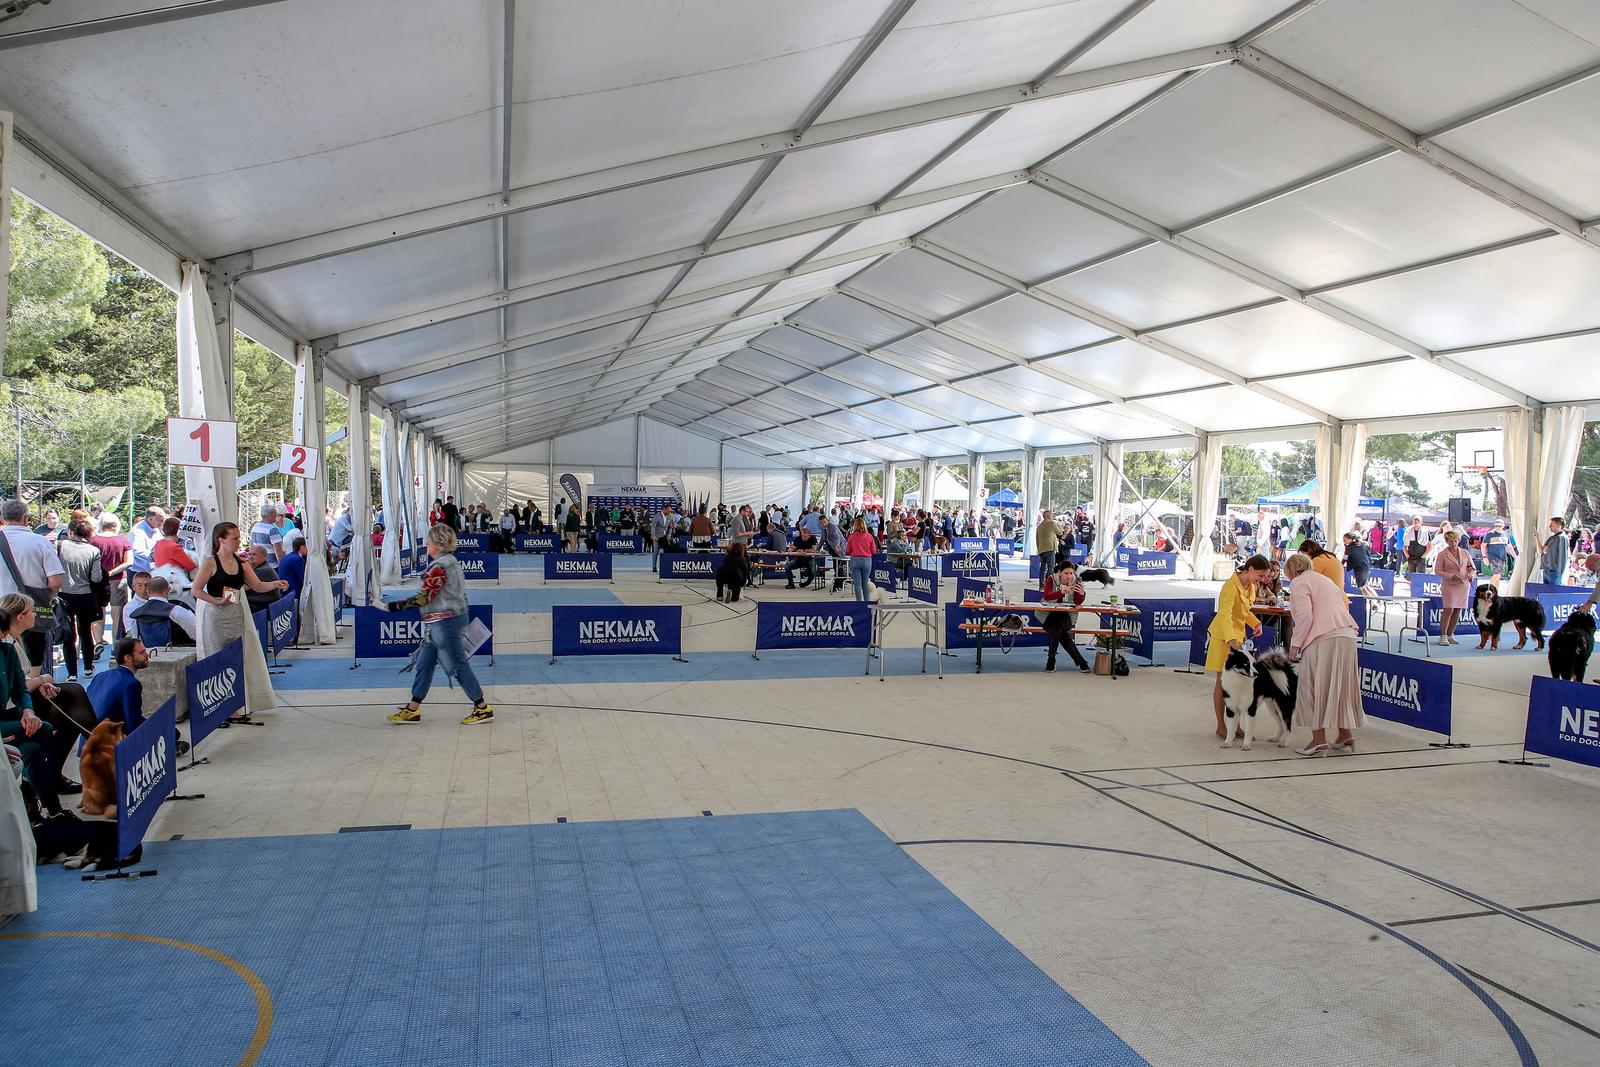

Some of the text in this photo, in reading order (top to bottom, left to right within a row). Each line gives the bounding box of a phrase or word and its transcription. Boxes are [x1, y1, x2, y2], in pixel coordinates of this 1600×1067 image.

[190, 422, 210, 462] 1
[290, 447, 307, 475] 2
[415, 476, 420, 487] 4
[980, 489, 986, 497] 3
[523, 539, 554, 547] NEKMAR
[606, 540, 635, 549] NEKMAR
[960, 542, 984, 550] NEKMAR
[556, 561, 599, 573] NEKMAR
[672, 561, 713, 573] NEKMAR
[952, 560, 989, 571] NEKMAR
[1136, 560, 1167, 570] NEKMAR
[1423, 582, 1443, 595] NEK
[1153, 611, 1196, 626] EKMAR
[579, 619, 660, 642] NEKMAR
[781, 615, 856, 637] NEKMAR
[196, 667, 237, 709] NEKMAR
[1381, 695, 1393, 704] DOG
[1393, 698, 1416, 710] PEOPLE
[1559, 733, 1577, 743] FOR
[126, 735, 166, 807] NEKMAR
